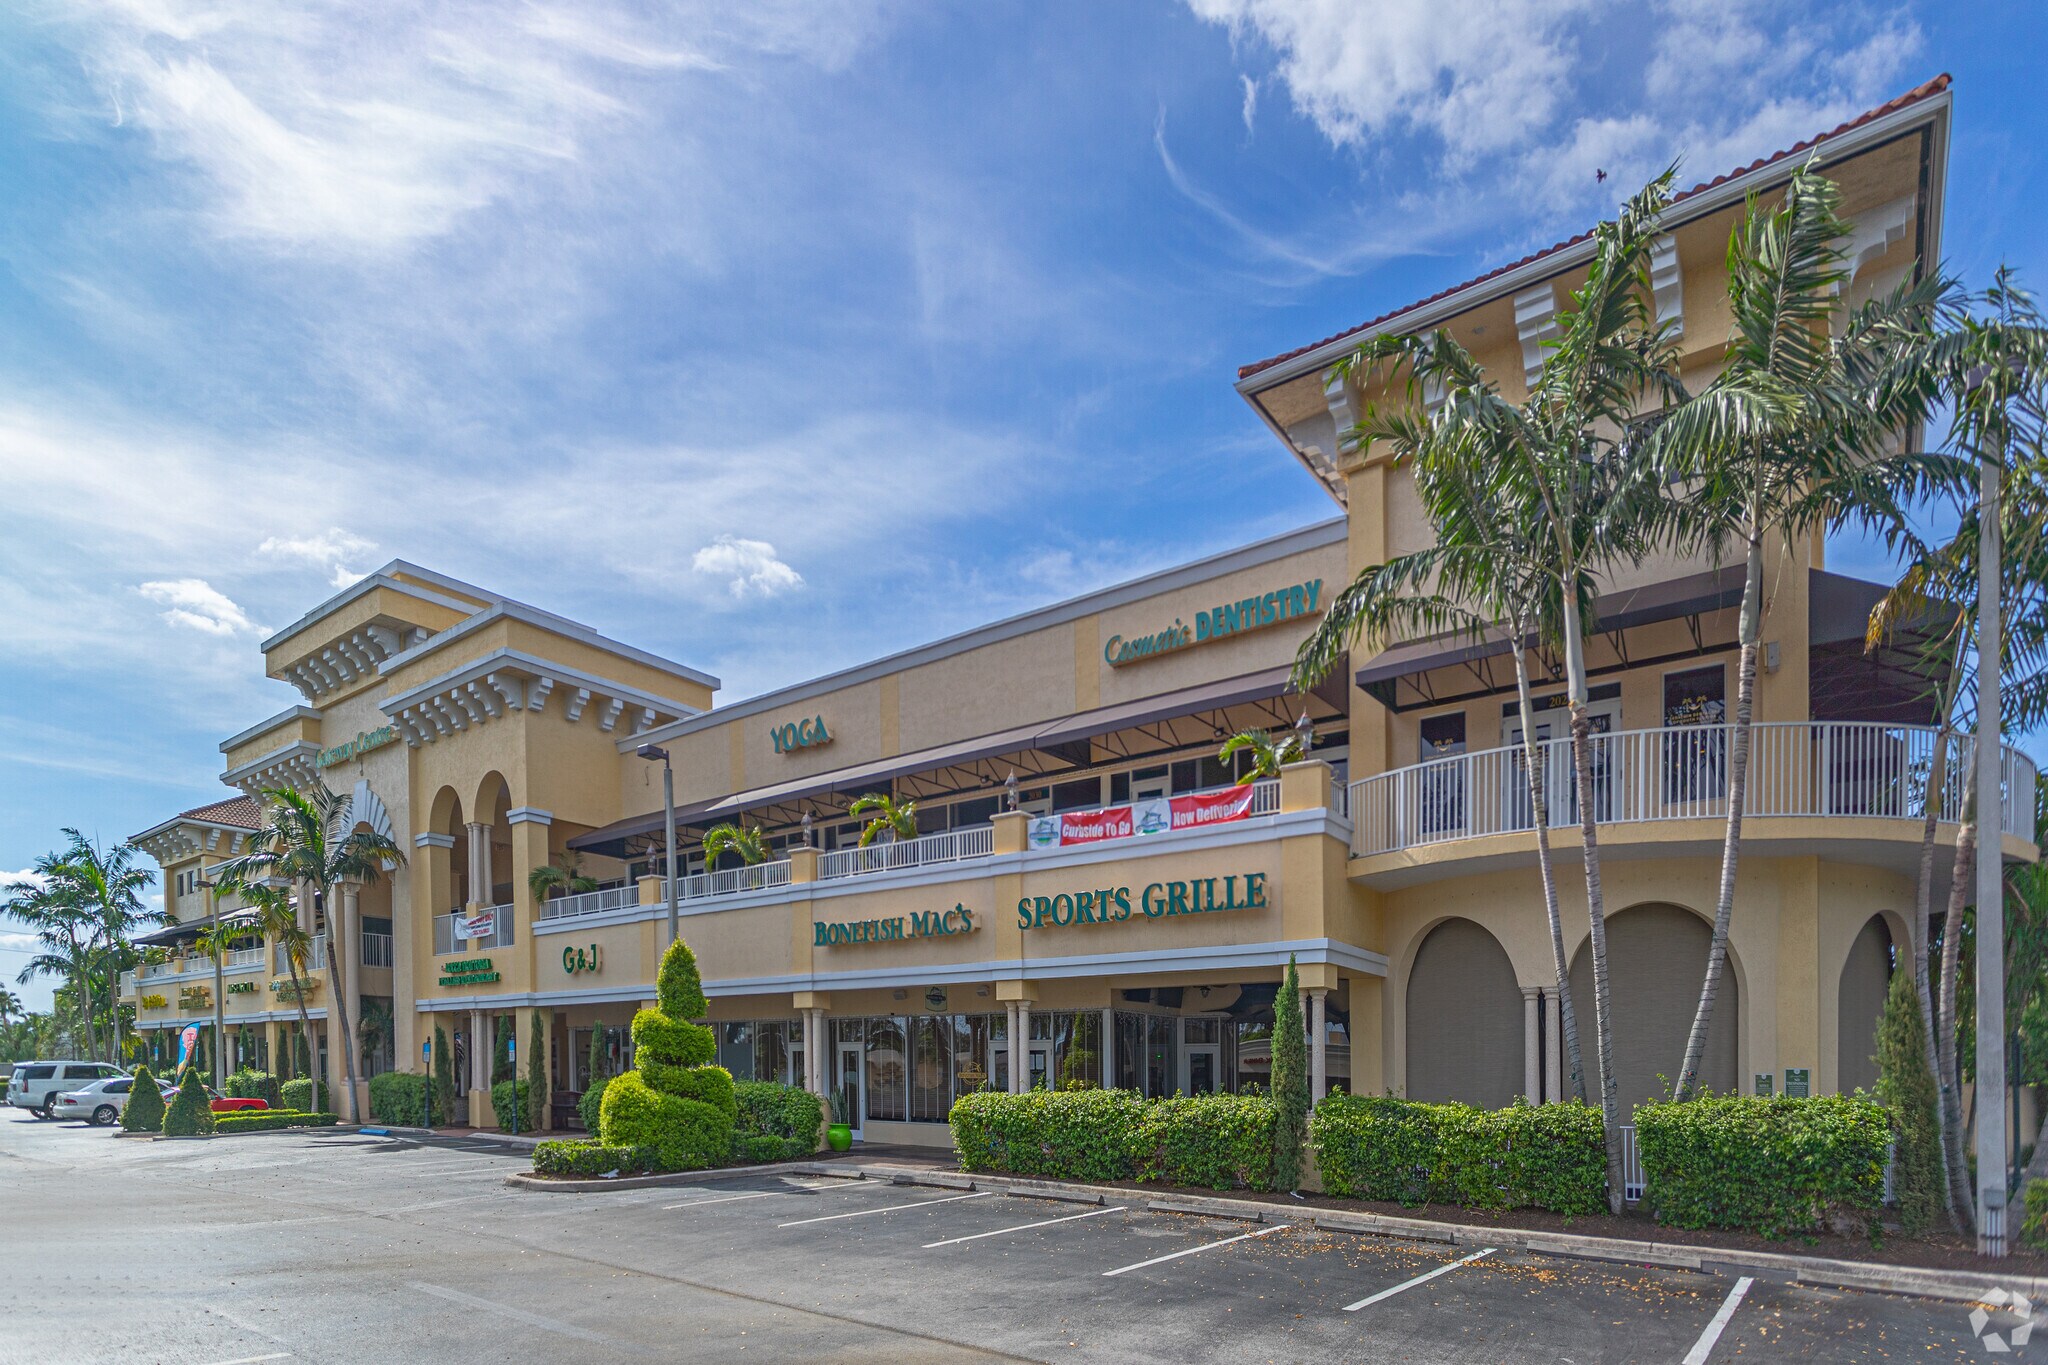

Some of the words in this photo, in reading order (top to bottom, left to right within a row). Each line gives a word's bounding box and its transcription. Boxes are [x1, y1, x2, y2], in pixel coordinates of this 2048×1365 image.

[1104, 617, 1189, 665] Cosmetic
[1195, 578, 1322, 641] DENTISTRY
[1549, 696, 1568, 708] 202
[770, 714, 829, 754] YOGA
[1062, 823, 1104, 838] Curbside
[1105, 822, 1117, 837] To
[1118, 821, 1130, 836] Go
[1173, 810, 1194, 827] Now
[1017, 886, 1131, 930] SPORTS
[1141, 872, 1267, 919] GRILLE
[814, 916, 904, 947] BONEFISH
[563, 944, 597, 974] G&J
